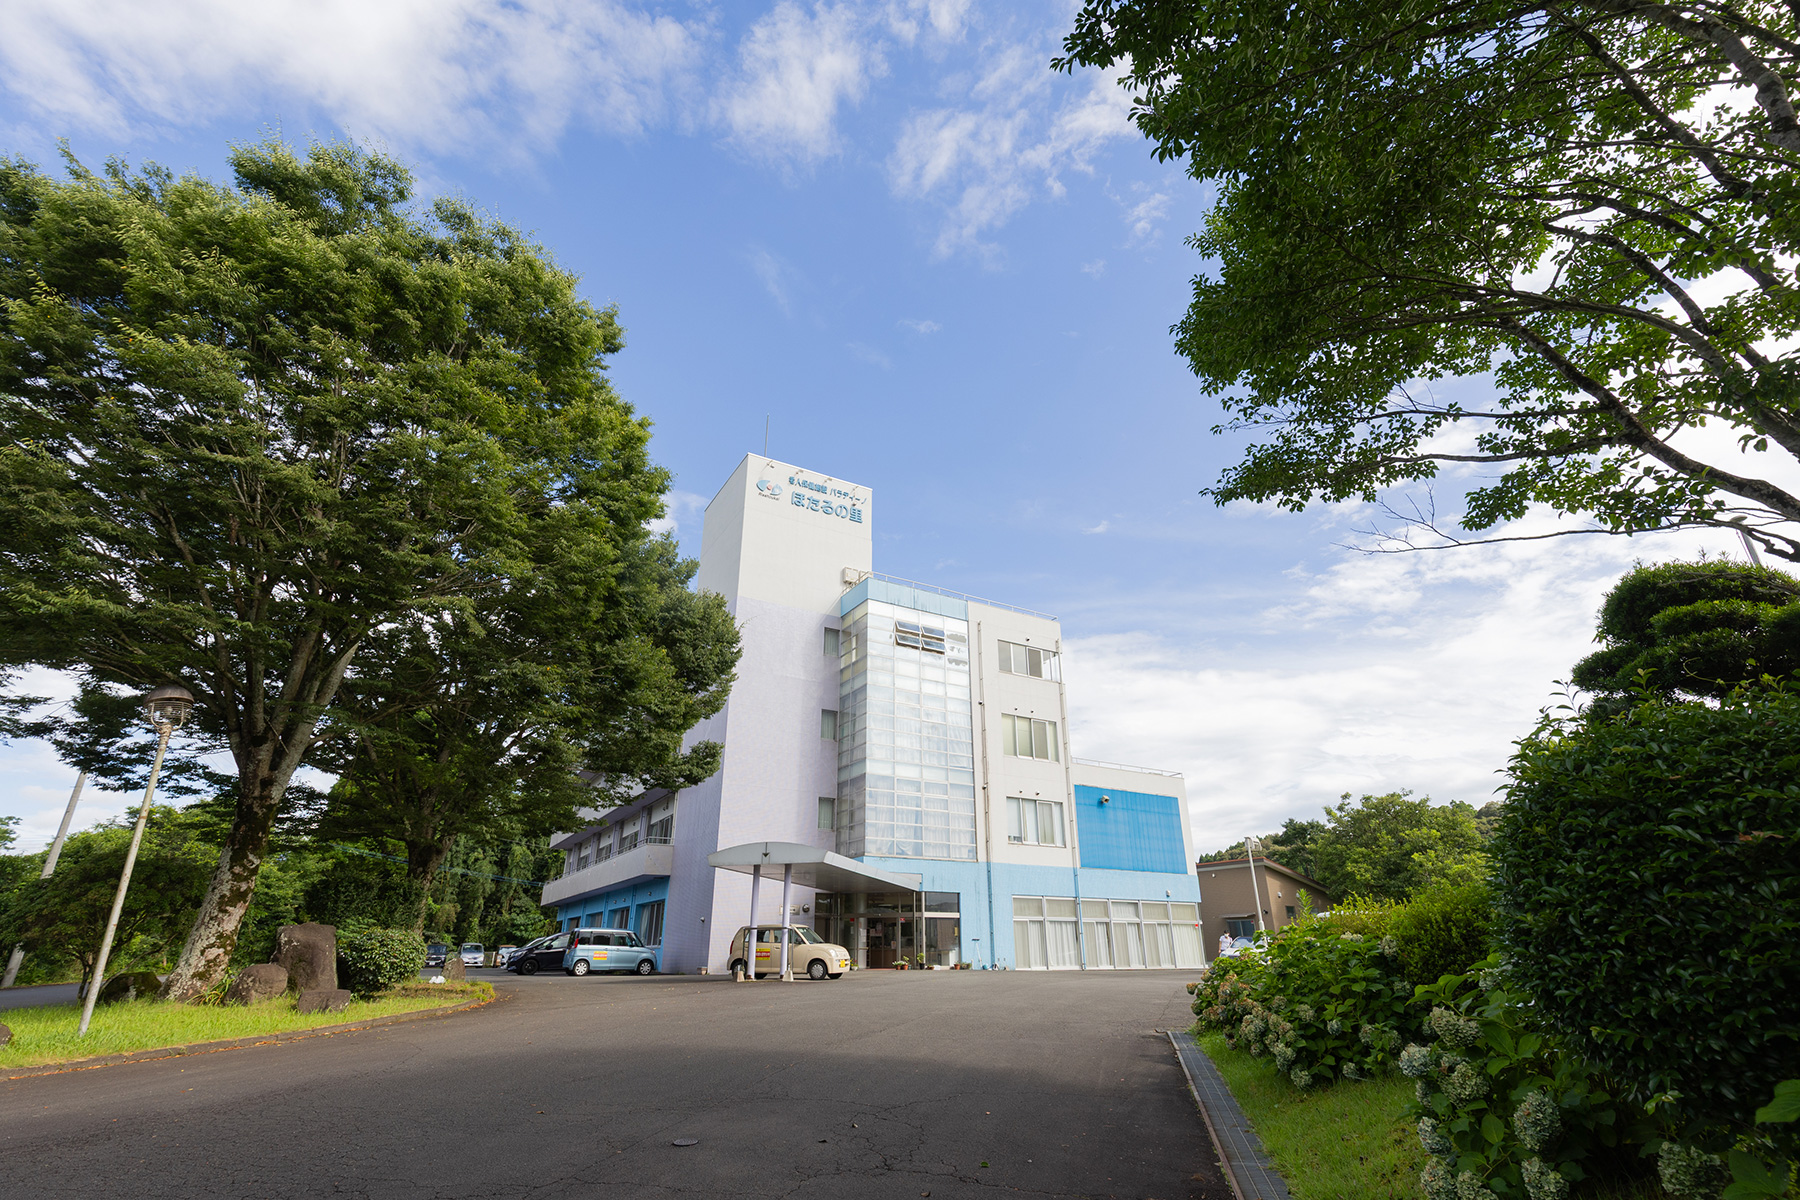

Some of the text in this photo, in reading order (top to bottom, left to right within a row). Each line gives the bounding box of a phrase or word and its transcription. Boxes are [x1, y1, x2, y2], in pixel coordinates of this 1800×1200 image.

[791, 491, 863, 524] ほたるの里
